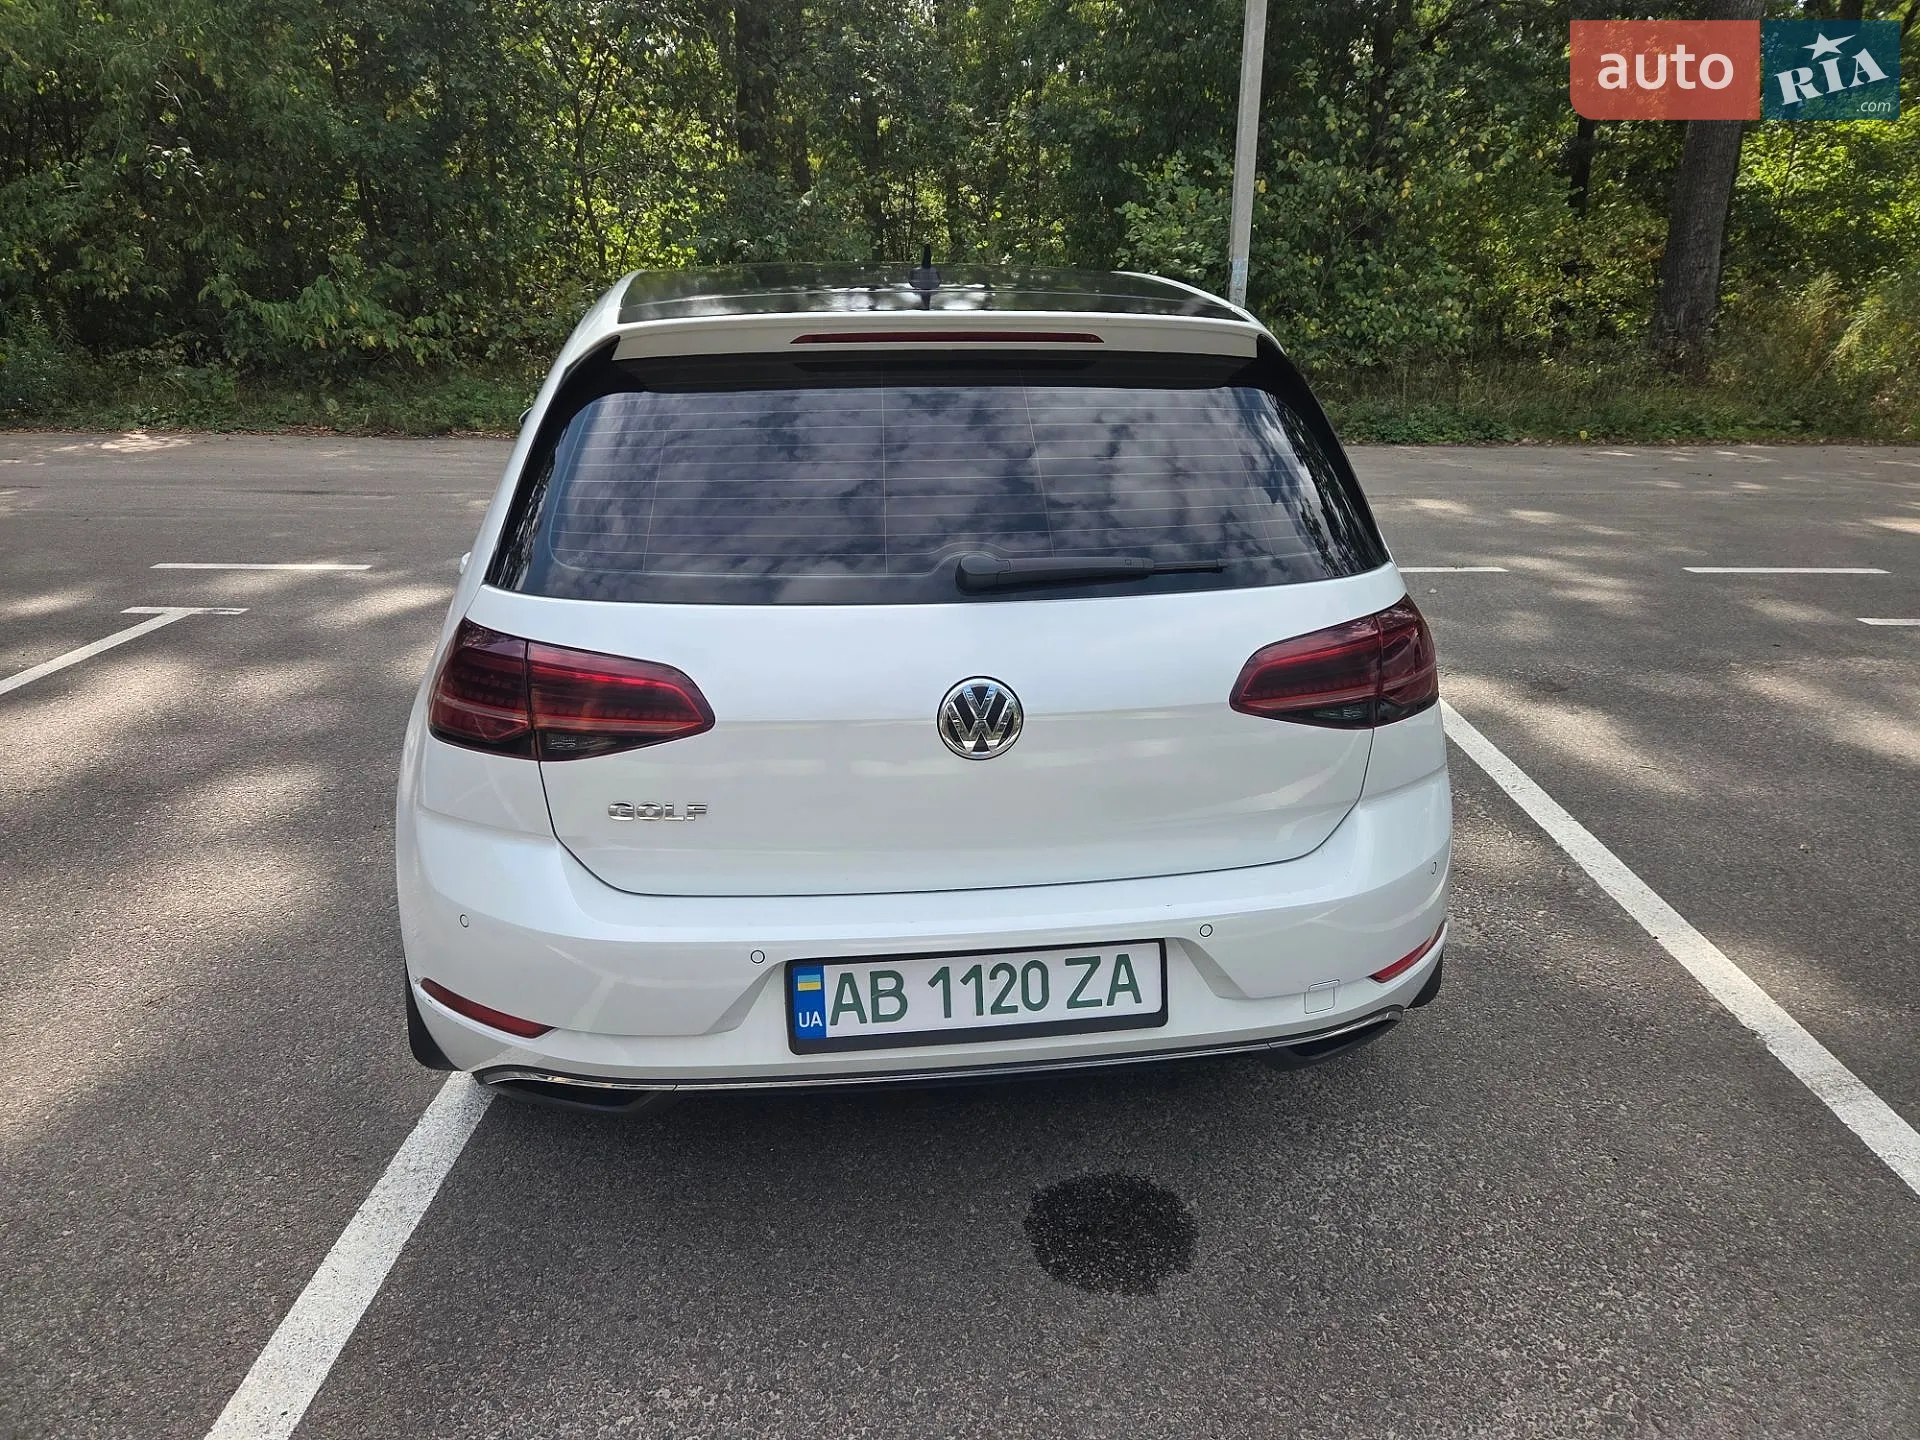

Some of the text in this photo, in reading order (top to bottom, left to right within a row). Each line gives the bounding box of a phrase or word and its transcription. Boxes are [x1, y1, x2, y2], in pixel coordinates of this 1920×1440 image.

[607, 801, 708, 821] GOLF
[829, 953, 1143, 1026] AB 1120 ZA
[798, 1011, 823, 1029] UA
